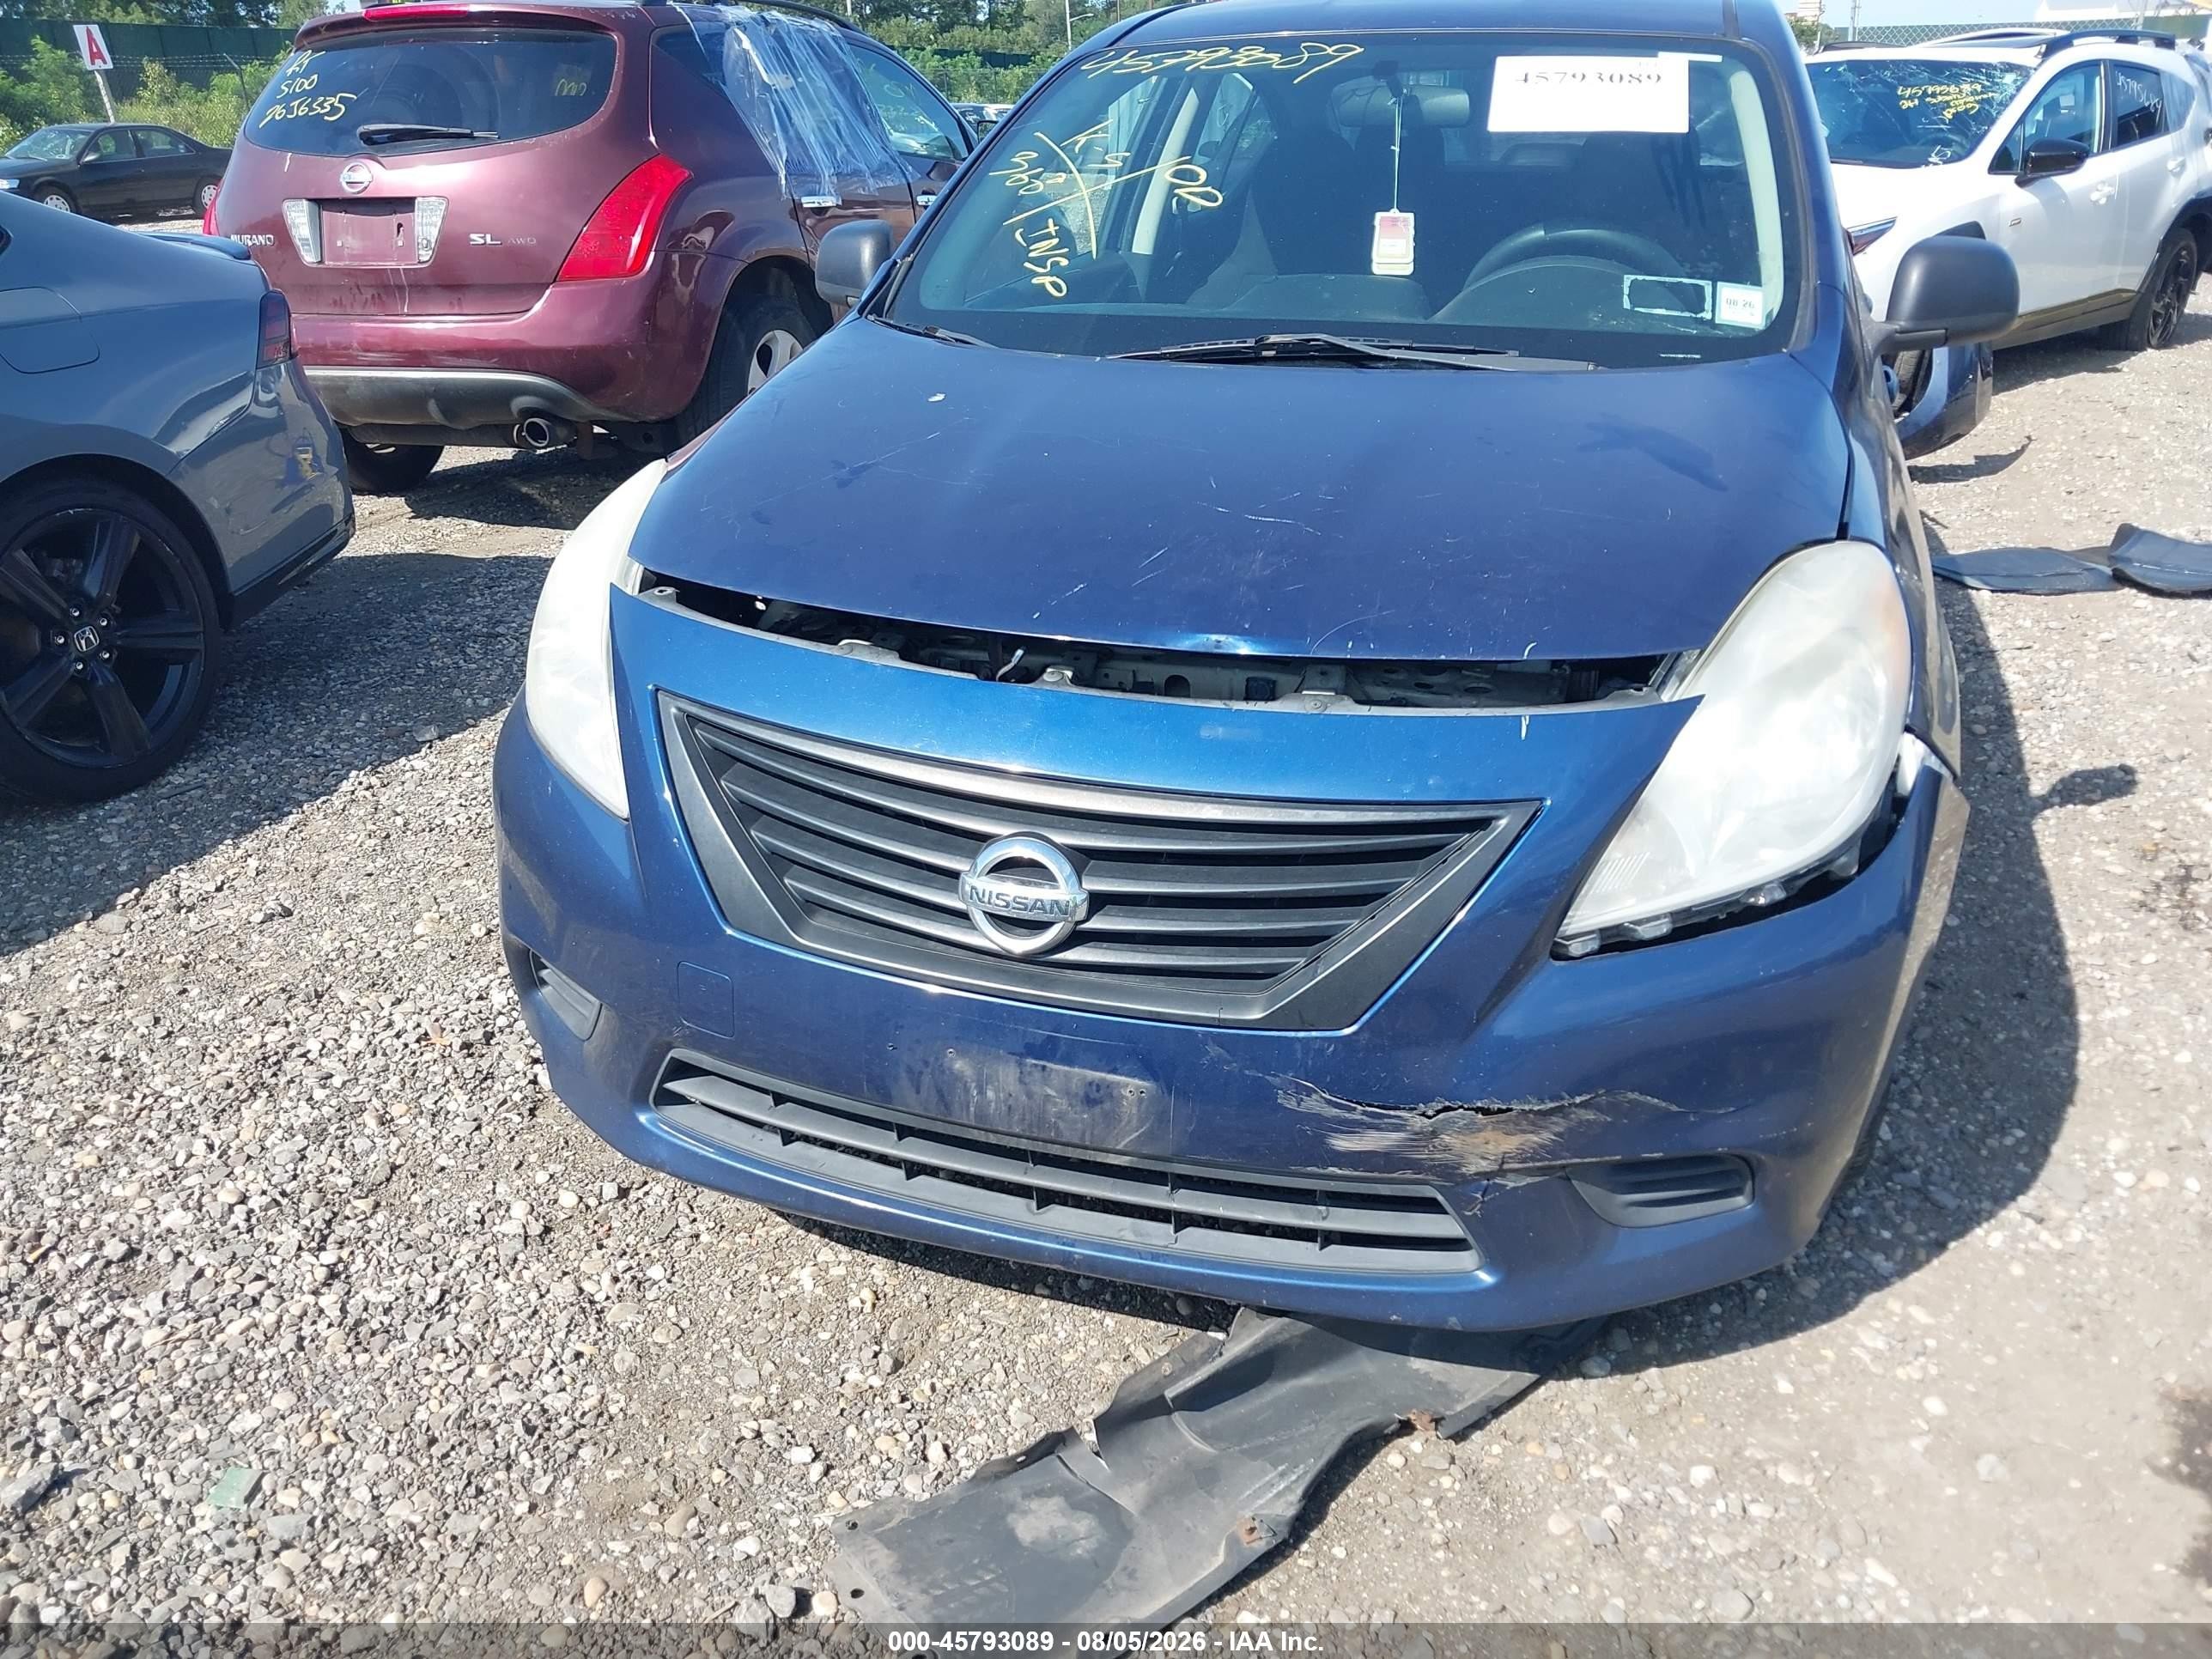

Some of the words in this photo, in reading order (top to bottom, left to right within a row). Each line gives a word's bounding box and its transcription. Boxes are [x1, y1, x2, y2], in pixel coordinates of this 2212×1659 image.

[86, 26, 107, 65] A
[230, 234, 274, 246] MURANO
[470, 234, 501, 246] SL
[969, 884, 1071, 917] NISSAN
